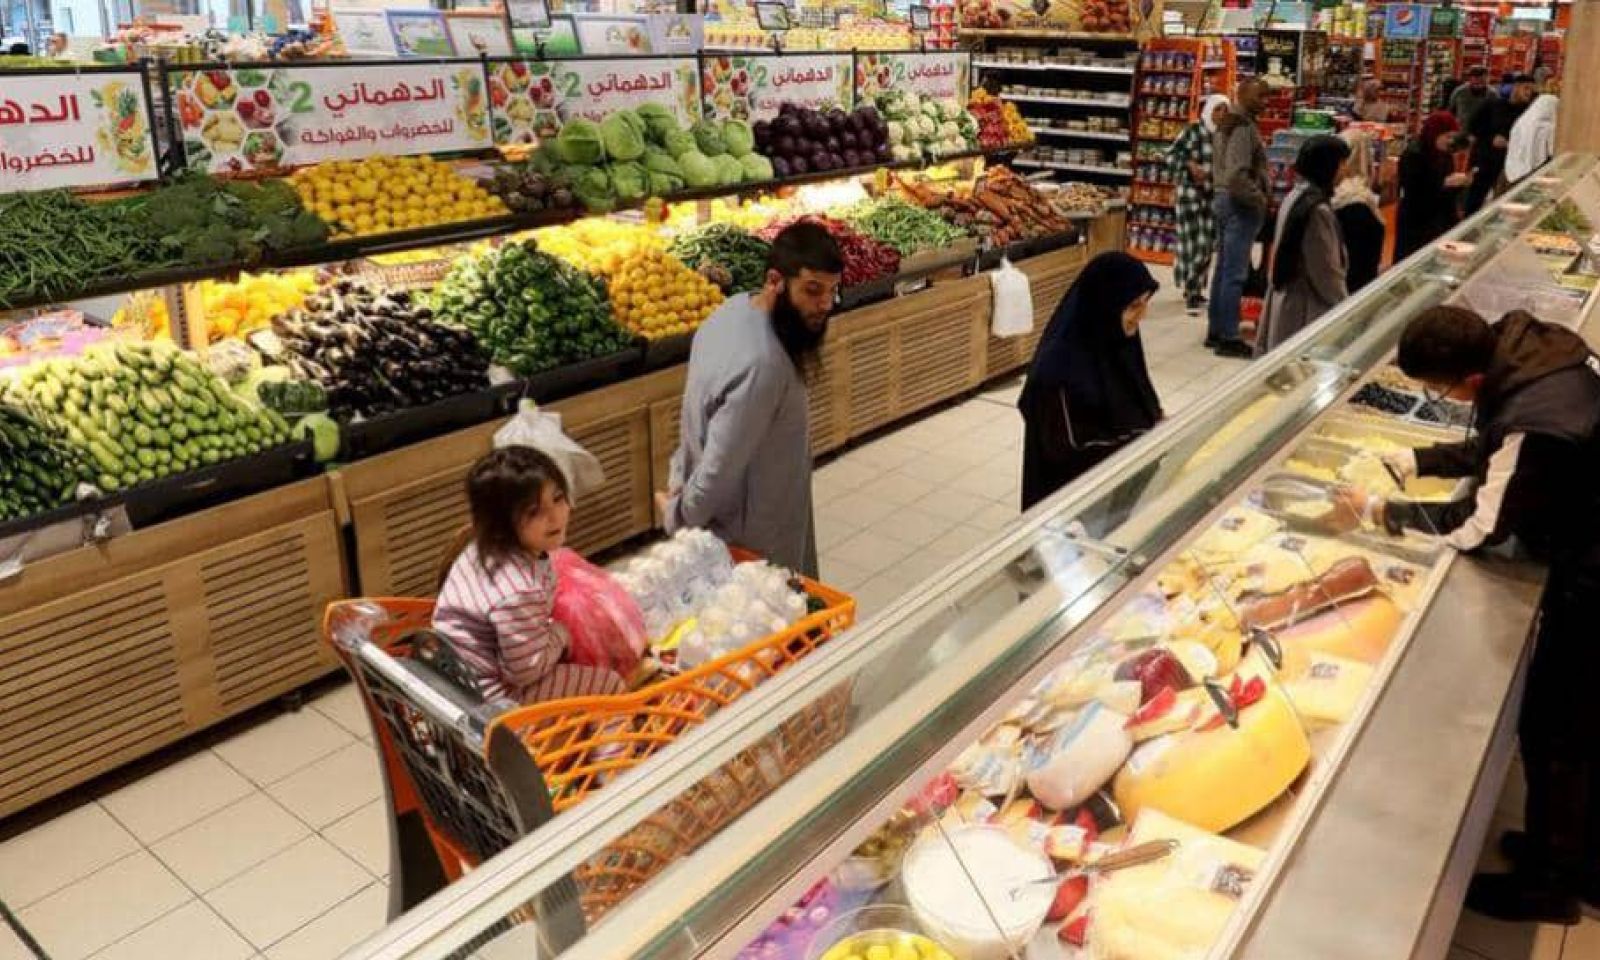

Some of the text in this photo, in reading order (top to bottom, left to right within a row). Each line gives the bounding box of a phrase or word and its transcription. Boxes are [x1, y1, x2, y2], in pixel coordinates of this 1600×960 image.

[564, 71, 672, 102] الدهماني 2
[756, 65, 768, 87] 2
[289, 77, 446, 118] الدهماني 2
